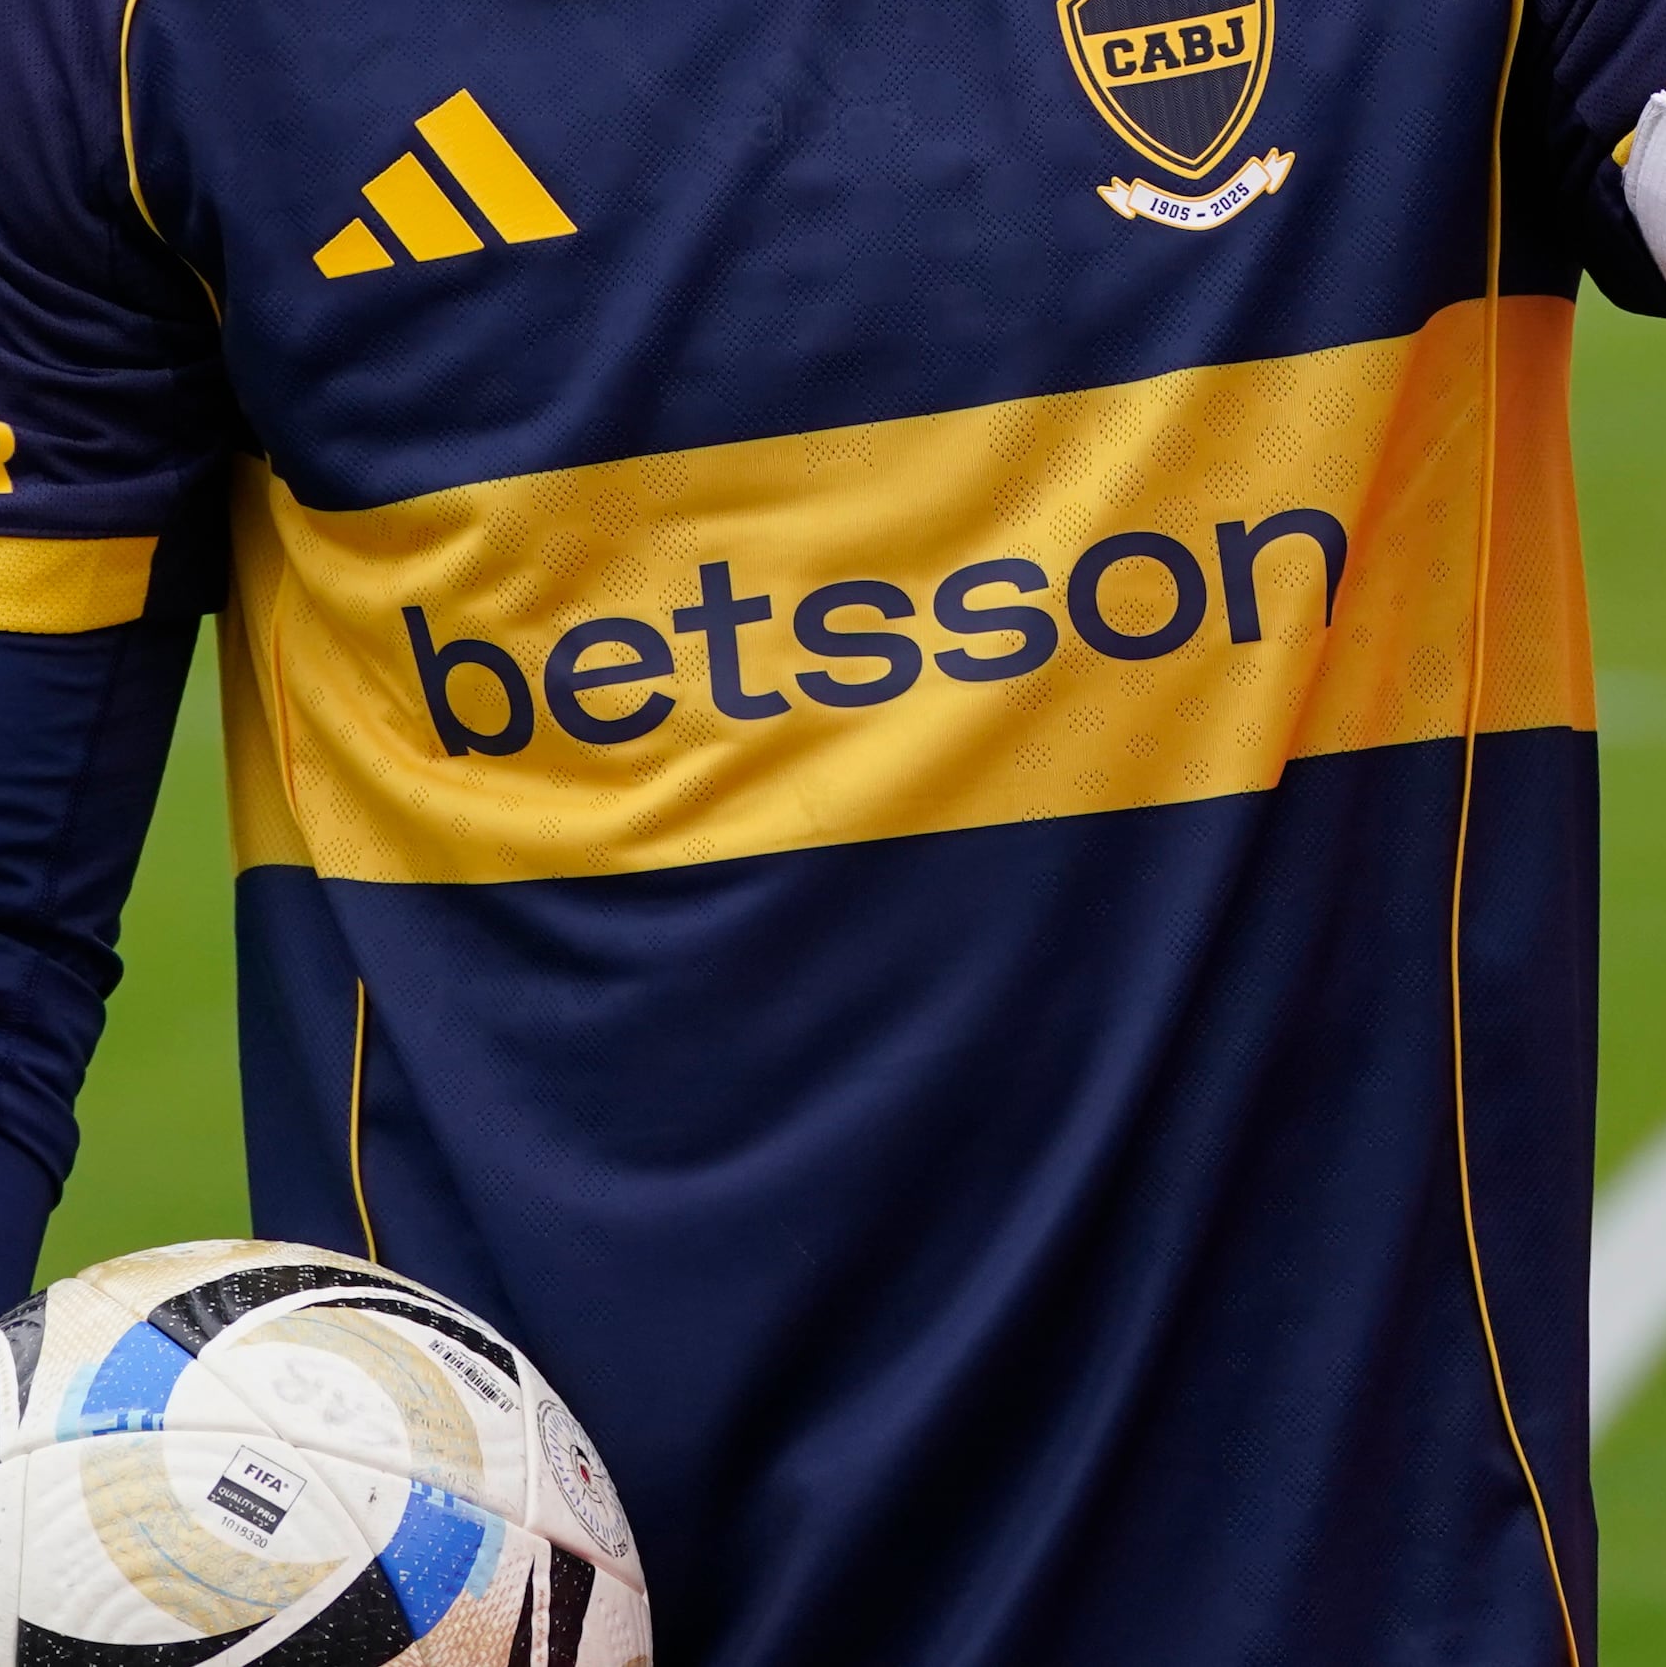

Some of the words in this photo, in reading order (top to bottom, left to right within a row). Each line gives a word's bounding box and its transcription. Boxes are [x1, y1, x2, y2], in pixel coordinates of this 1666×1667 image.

[1102, 16, 1245, 78] CABJ
[1149, 197, 1191, 221] 1905
[1210, 182, 1250, 217] 2025
[400, 507, 1349, 758] betsson
[244, 1463, 283, 1493] FIFA
[218, 1486, 258, 1511] QUALITY
[256, 1506, 278, 1523] PRO
